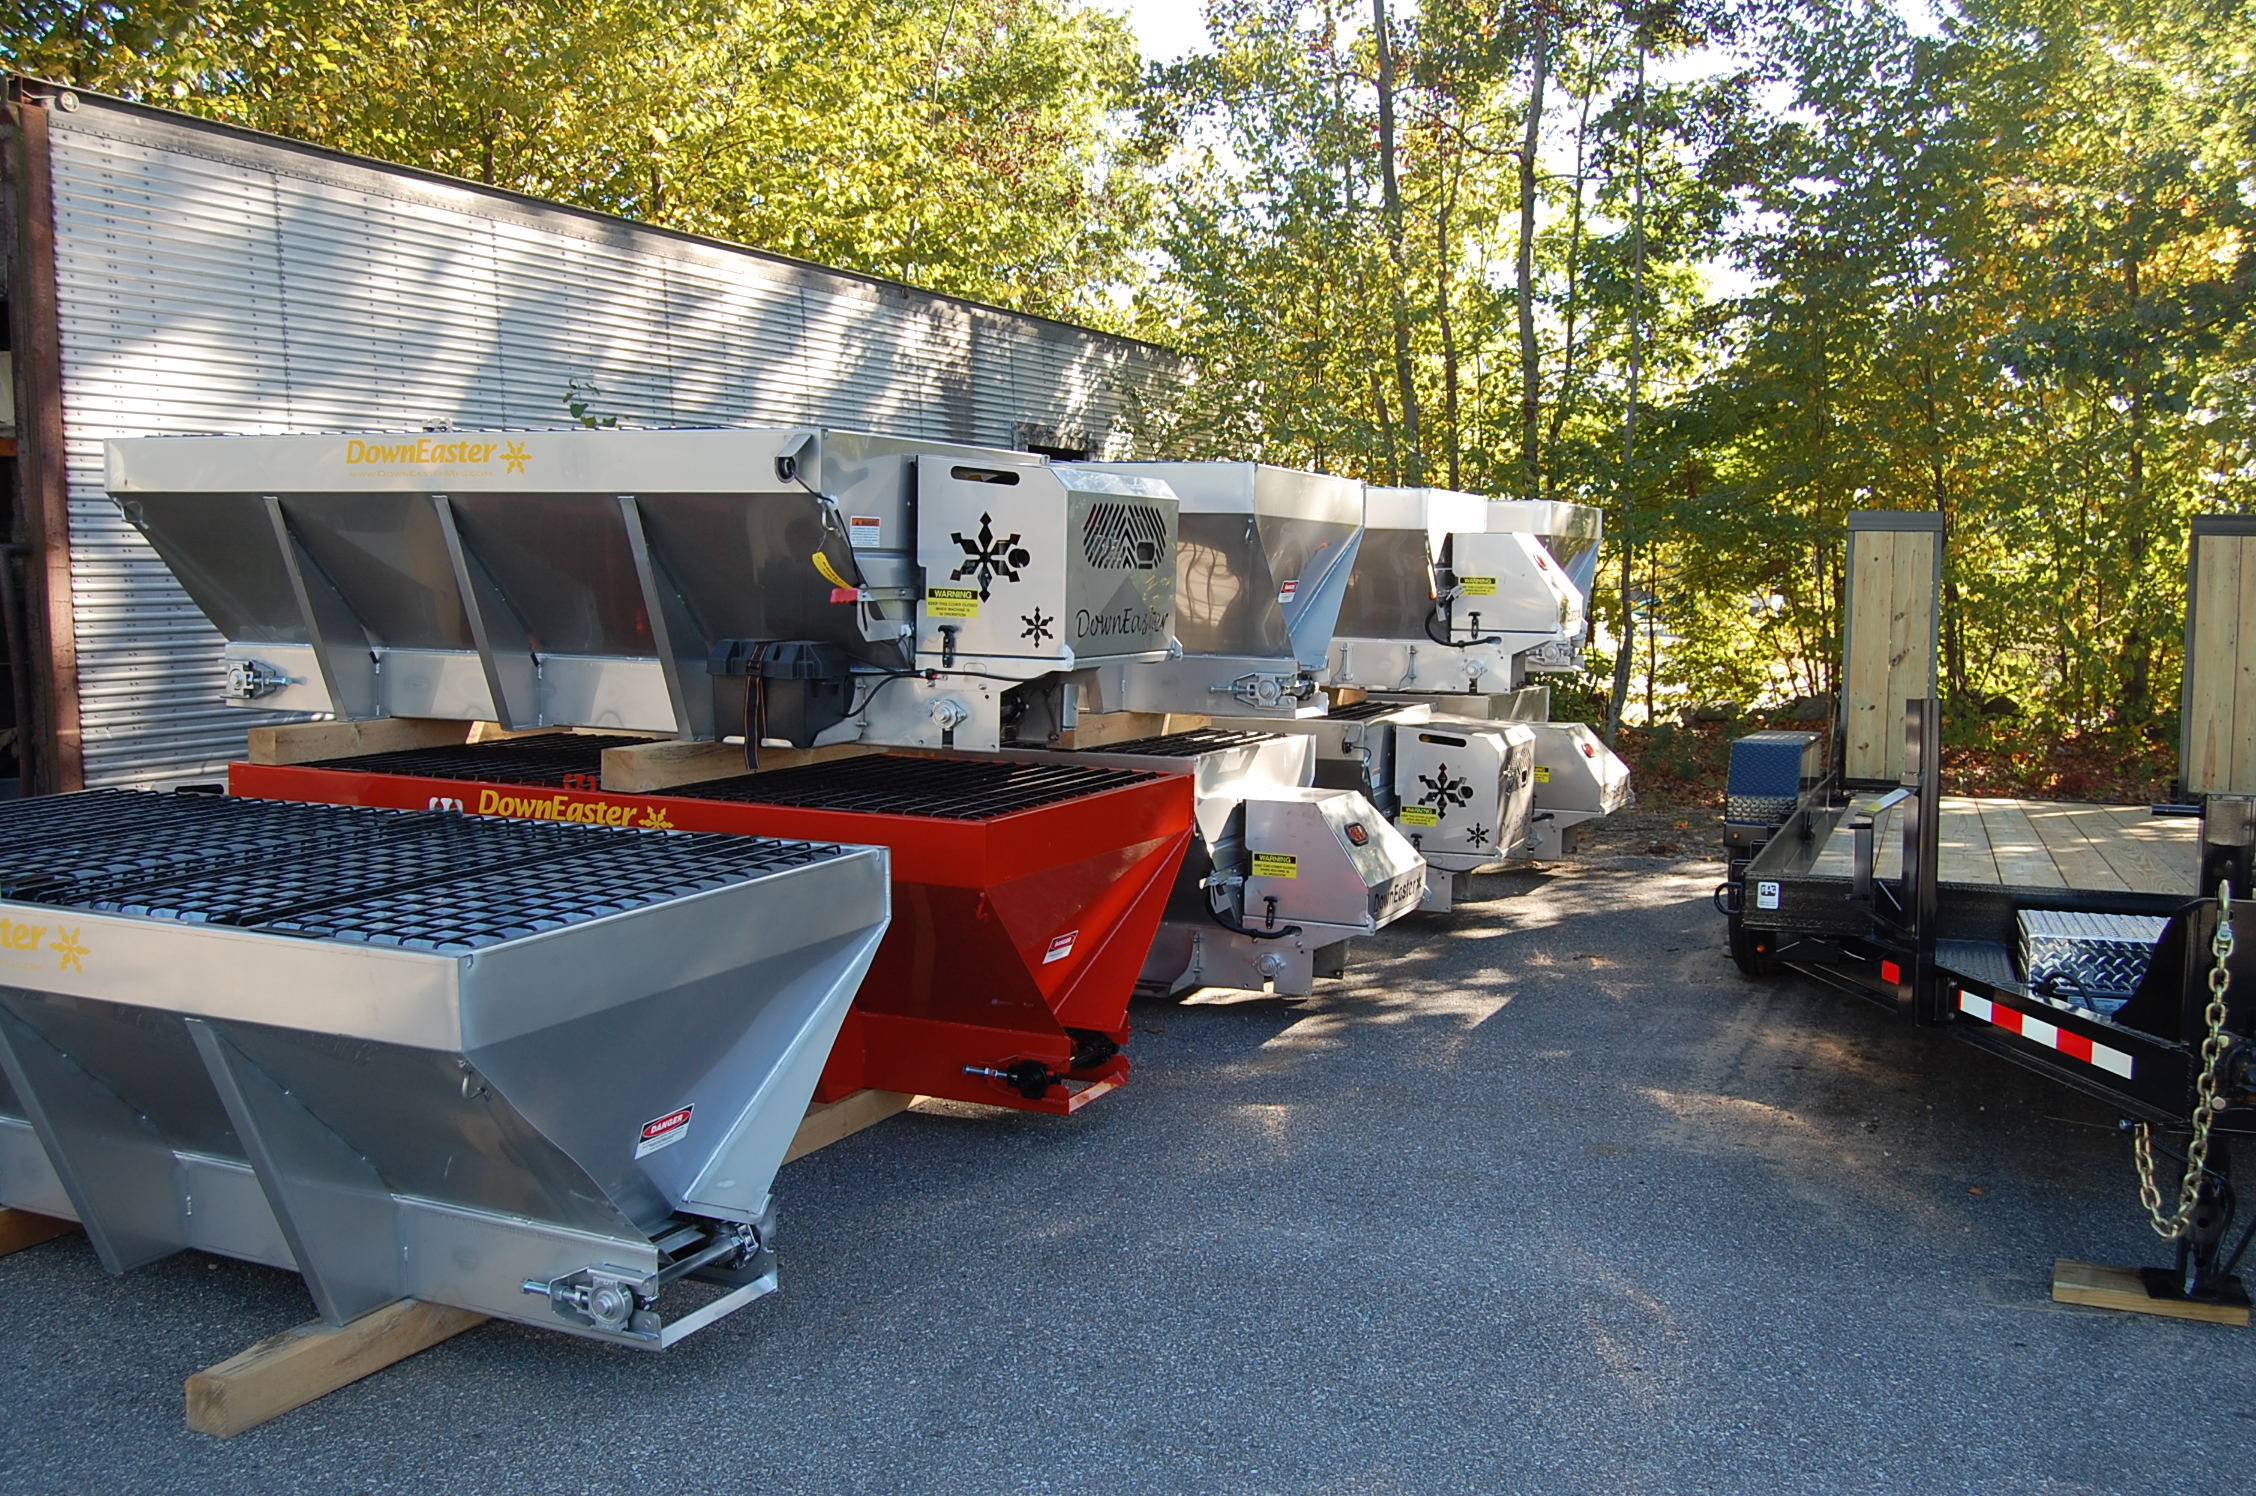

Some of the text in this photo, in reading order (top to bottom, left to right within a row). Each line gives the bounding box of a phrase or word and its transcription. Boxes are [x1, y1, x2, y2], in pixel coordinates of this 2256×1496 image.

[346, 438, 497, 464] DownEaster
[934, 589, 972, 599] WARNING
[1076, 607, 1168, 638] DownEaster
[478, 789, 637, 826] DownEaster
[1259, 855, 1290, 864] WARNING
[0, 917, 47, 952] ter
[650, 1114, 683, 1134] DANGER
